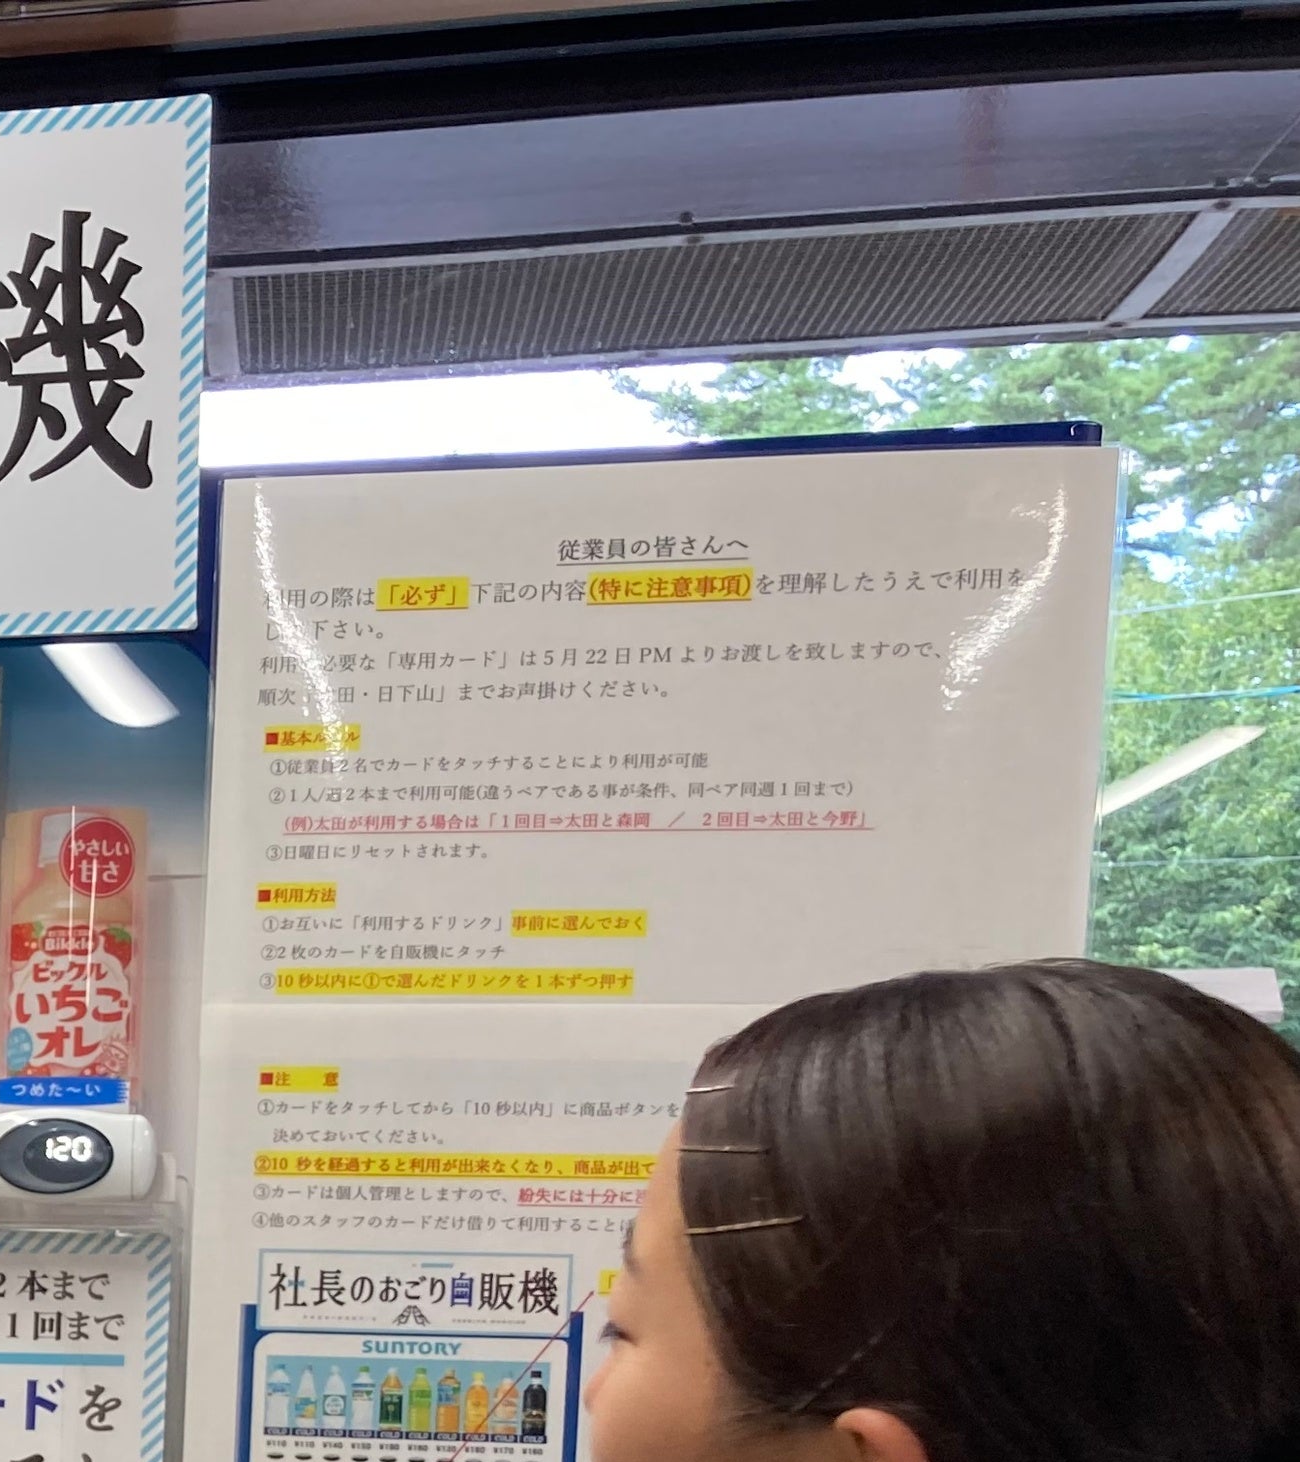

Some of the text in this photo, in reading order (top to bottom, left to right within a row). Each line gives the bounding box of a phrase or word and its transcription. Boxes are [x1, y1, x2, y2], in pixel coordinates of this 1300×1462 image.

[557, 535, 749, 562] 従業員の皆さんへ
[68, 839, 131, 858] やさしい
[78, 860, 120, 884] 甘さ
[272, 887, 336, 905] 利用方法
[32, 960, 108, 983] ビックル
[15, 984, 129, 1024] いちご
[33, 1025, 102, 1059] オレ
[46, 1136, 91, 1161] 120
[272, 1128, 446, 1146] 決めておいてください。
[268, 1262, 560, 1317] 社長のおごり自販機
[361, 1339, 463, 1357] SUNTORY
